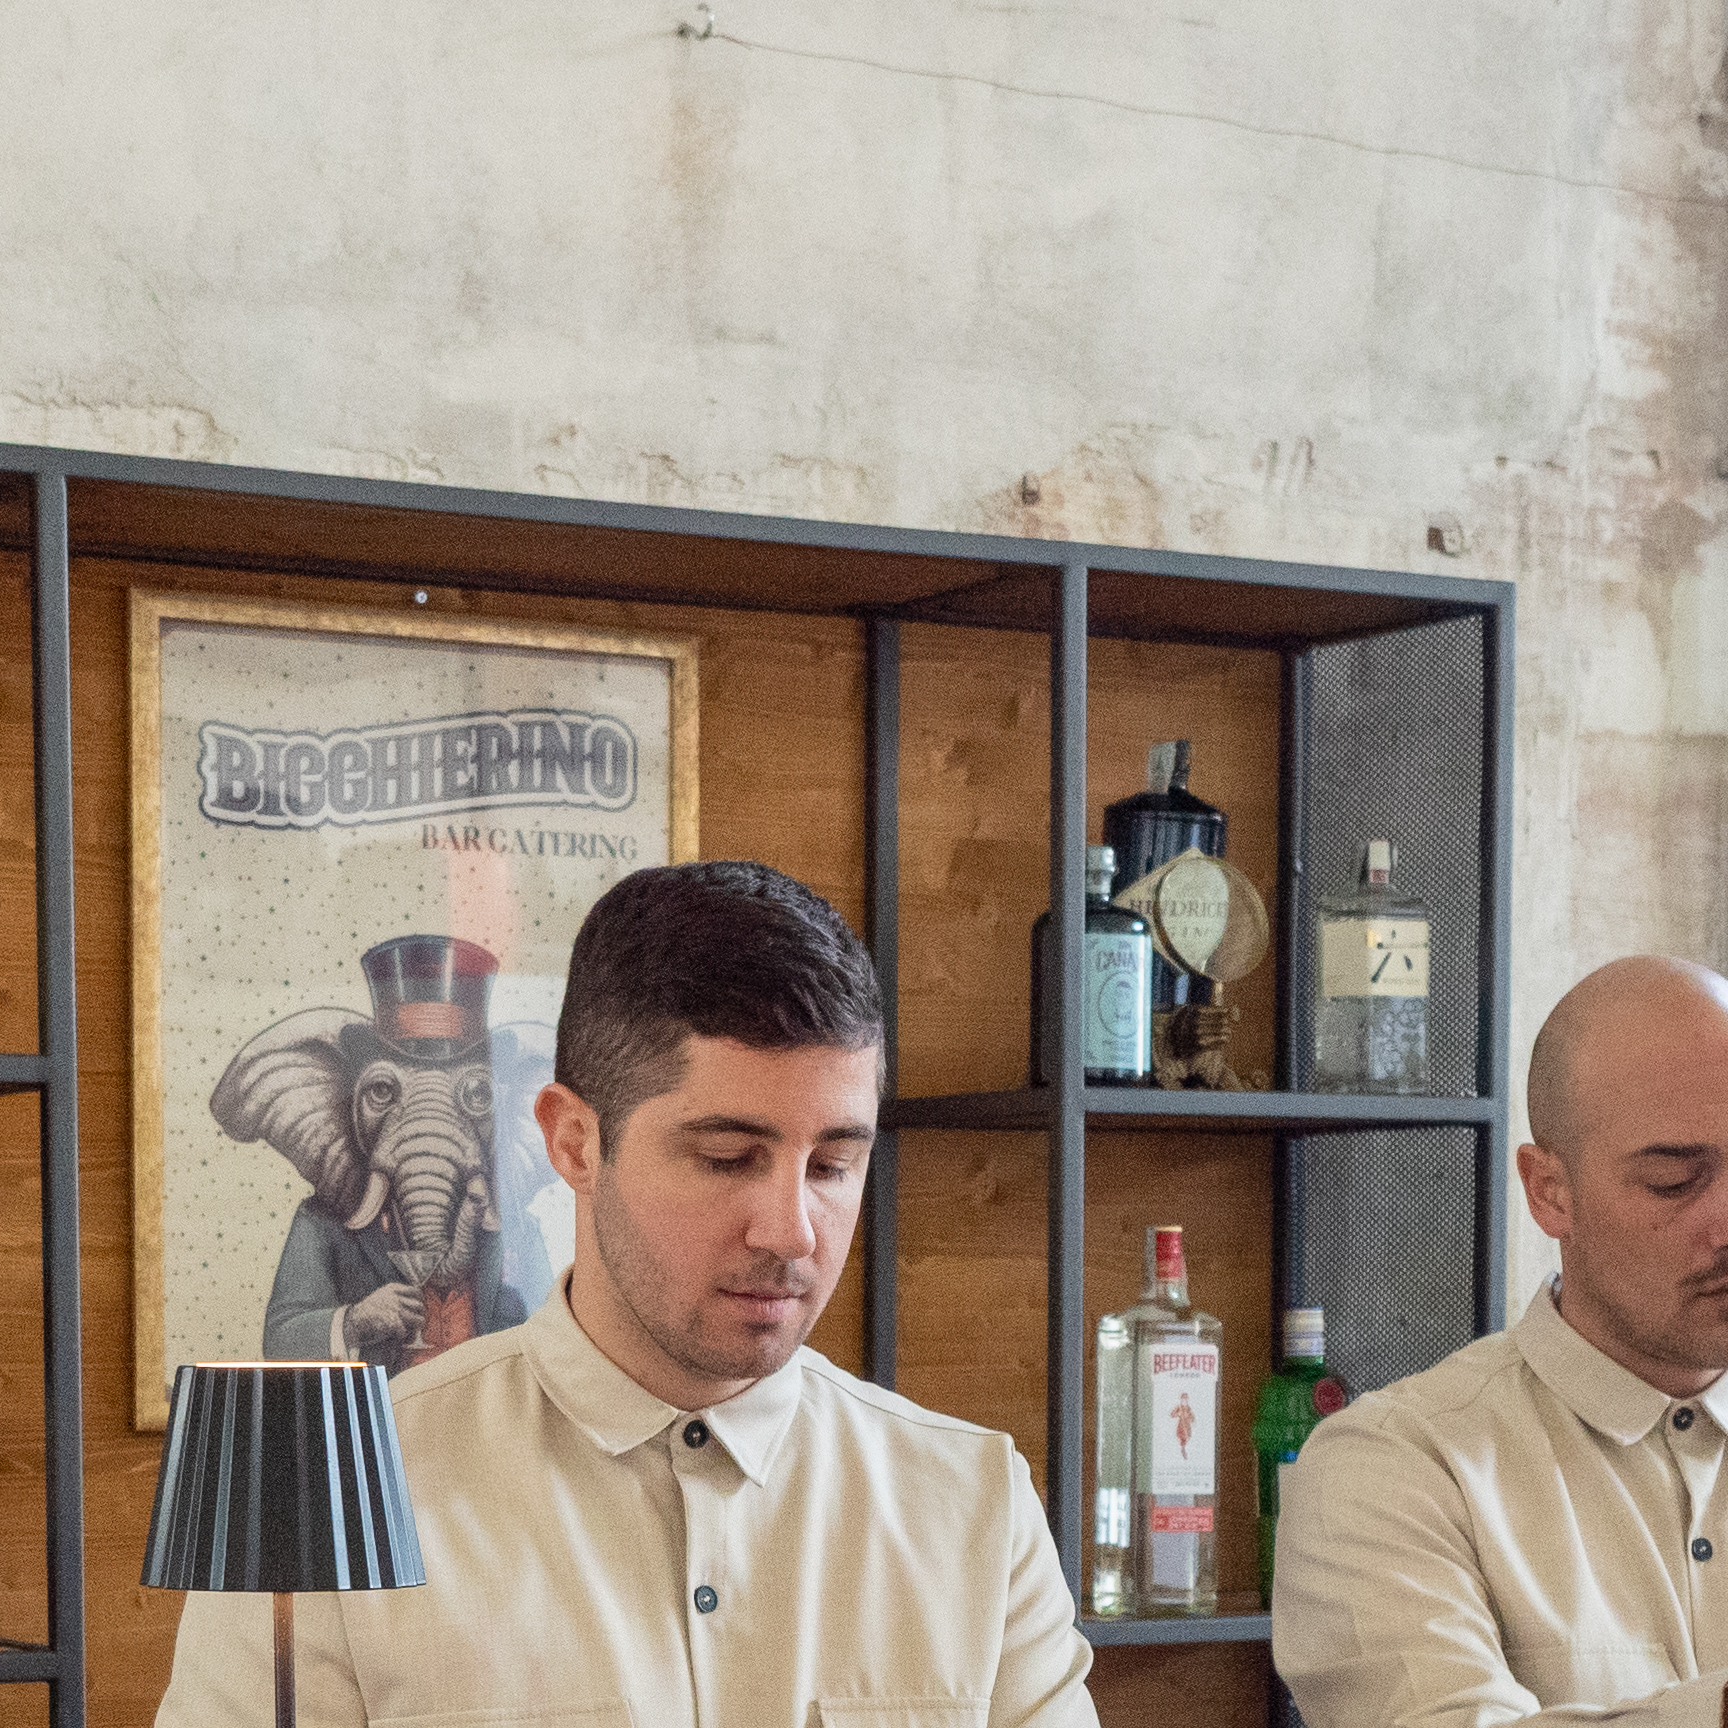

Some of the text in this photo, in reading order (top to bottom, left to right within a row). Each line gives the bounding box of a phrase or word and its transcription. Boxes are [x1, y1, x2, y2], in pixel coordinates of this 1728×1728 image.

[206, 719, 629, 818] BICCHIERINO
[422, 823, 639, 860] BAR CATERING
[1153, 1354, 1216, 1375] BEEFEATER
